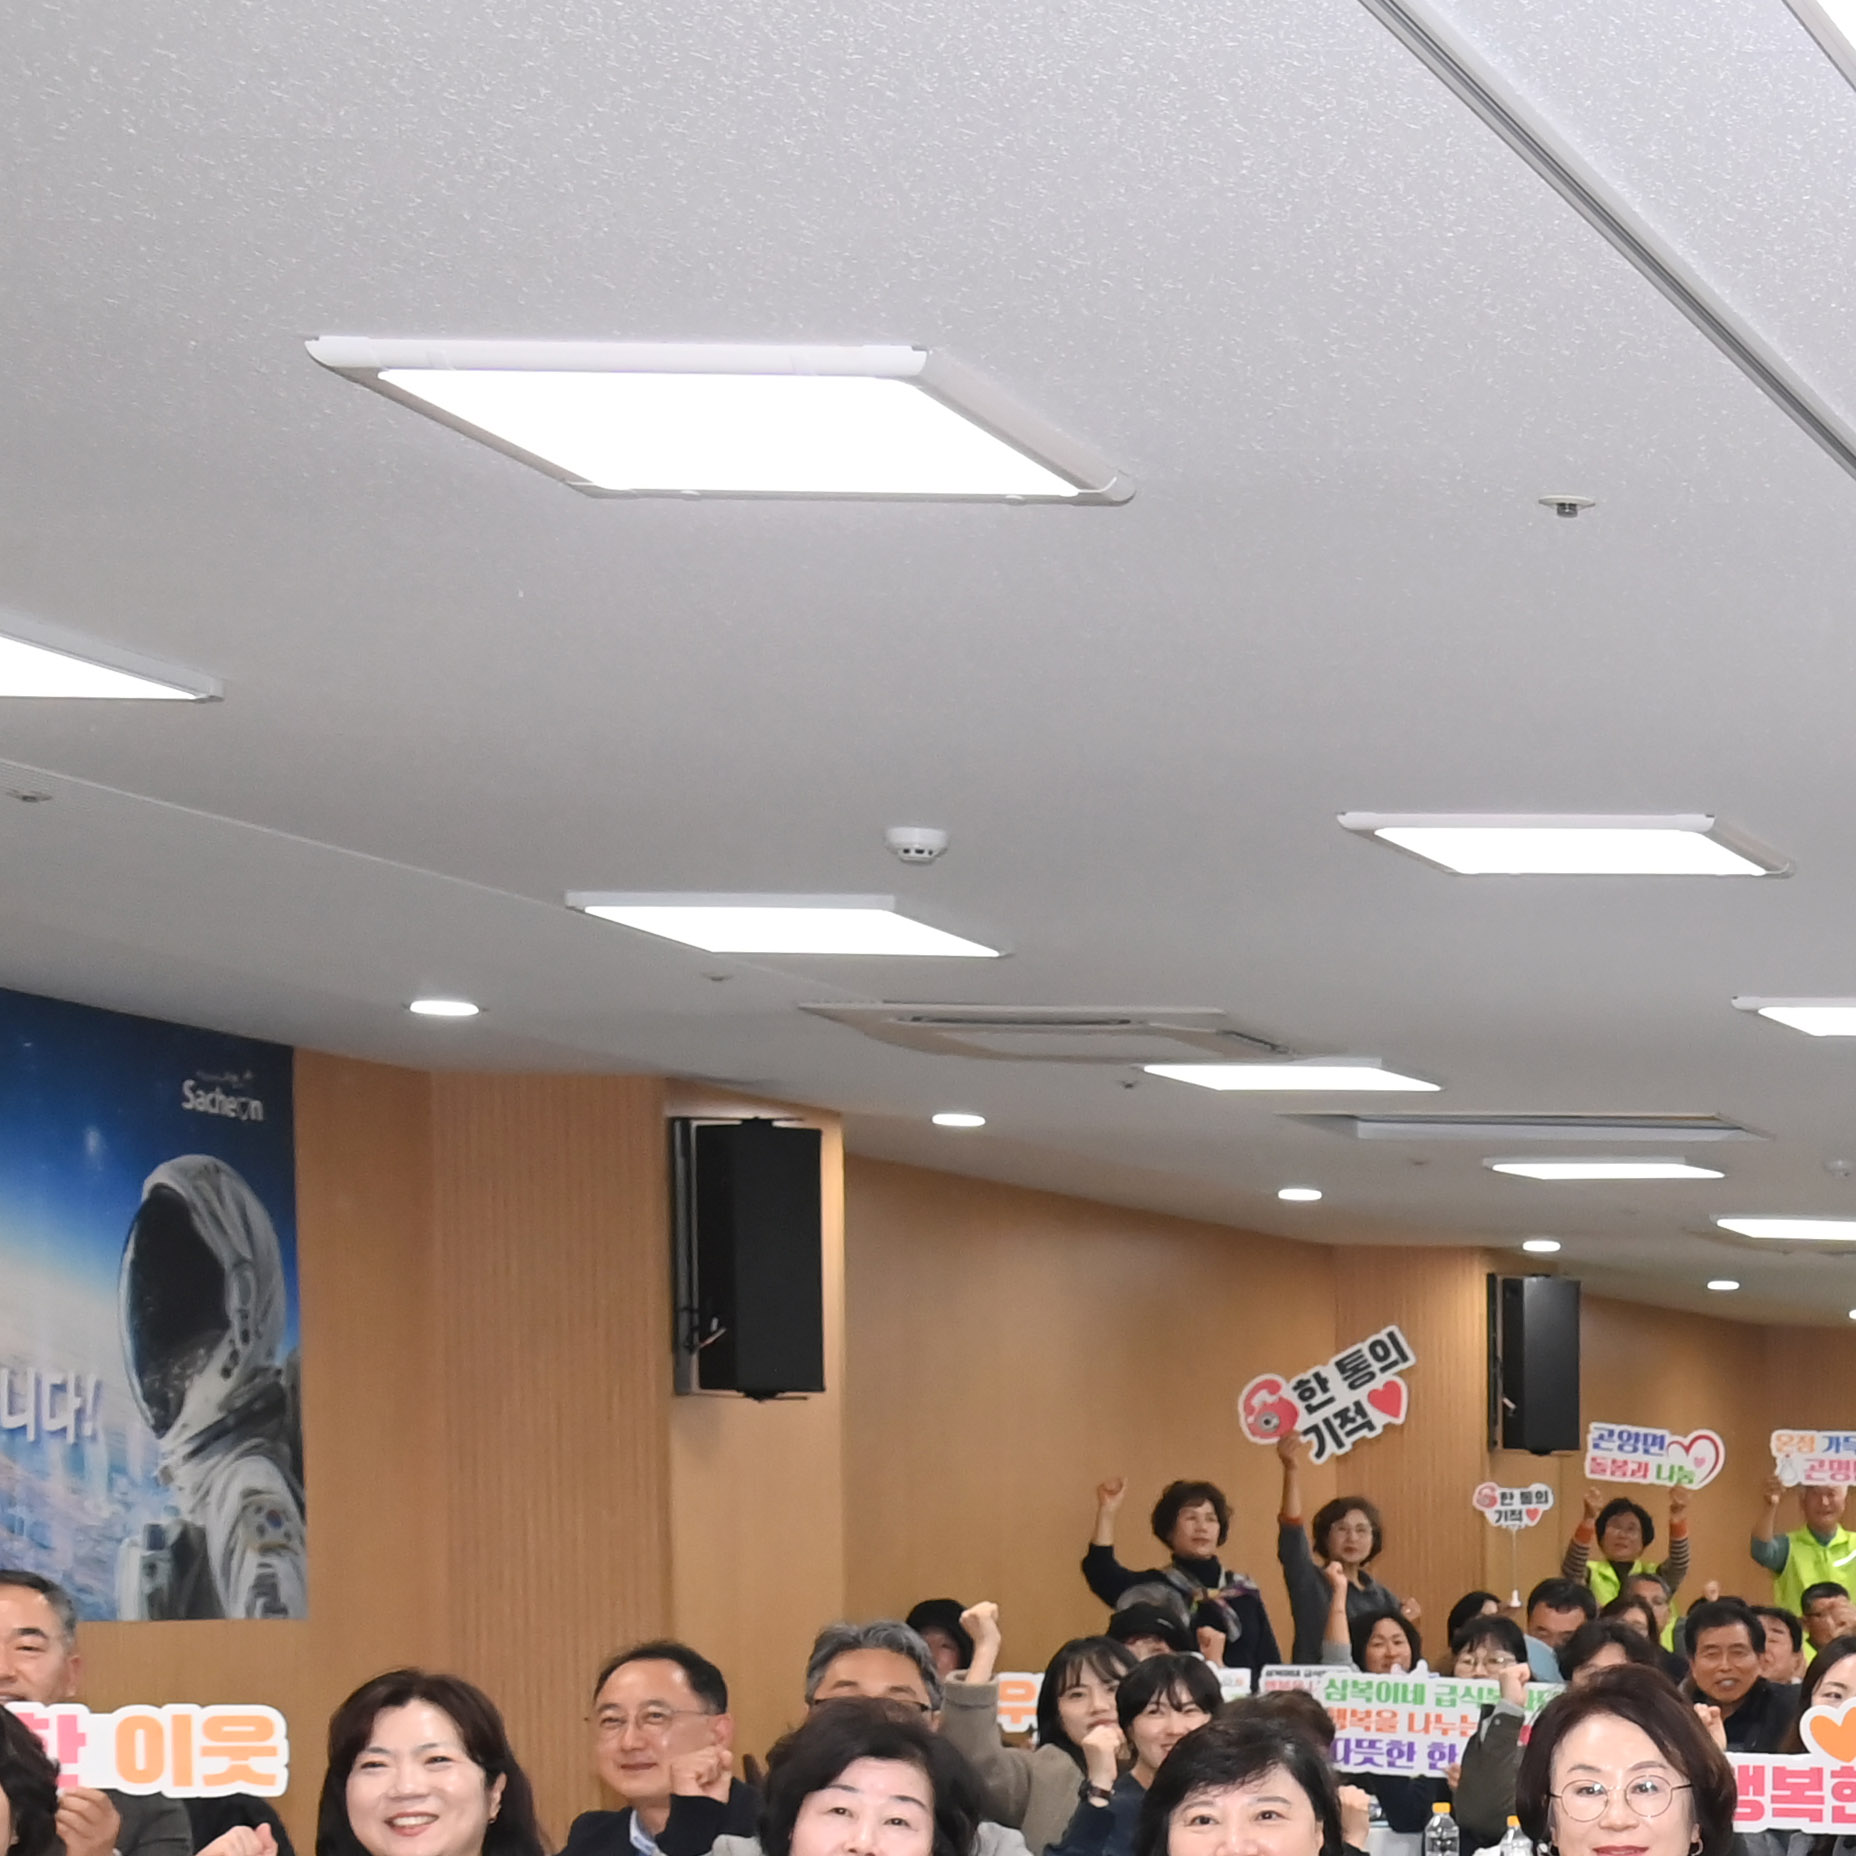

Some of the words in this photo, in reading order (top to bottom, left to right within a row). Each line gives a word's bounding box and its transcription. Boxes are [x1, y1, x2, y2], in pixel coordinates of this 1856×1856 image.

[1292, 1371, 1335, 1415] 한
[1335, 1330, 1409, 1391] 통의
[1302, 1400, 1376, 1459] 기적
[1592, 1427, 1666, 1457] 곤양면
[1494, 1509, 1523, 1524] 기적
[115, 1714, 278, 1788] 이웃
